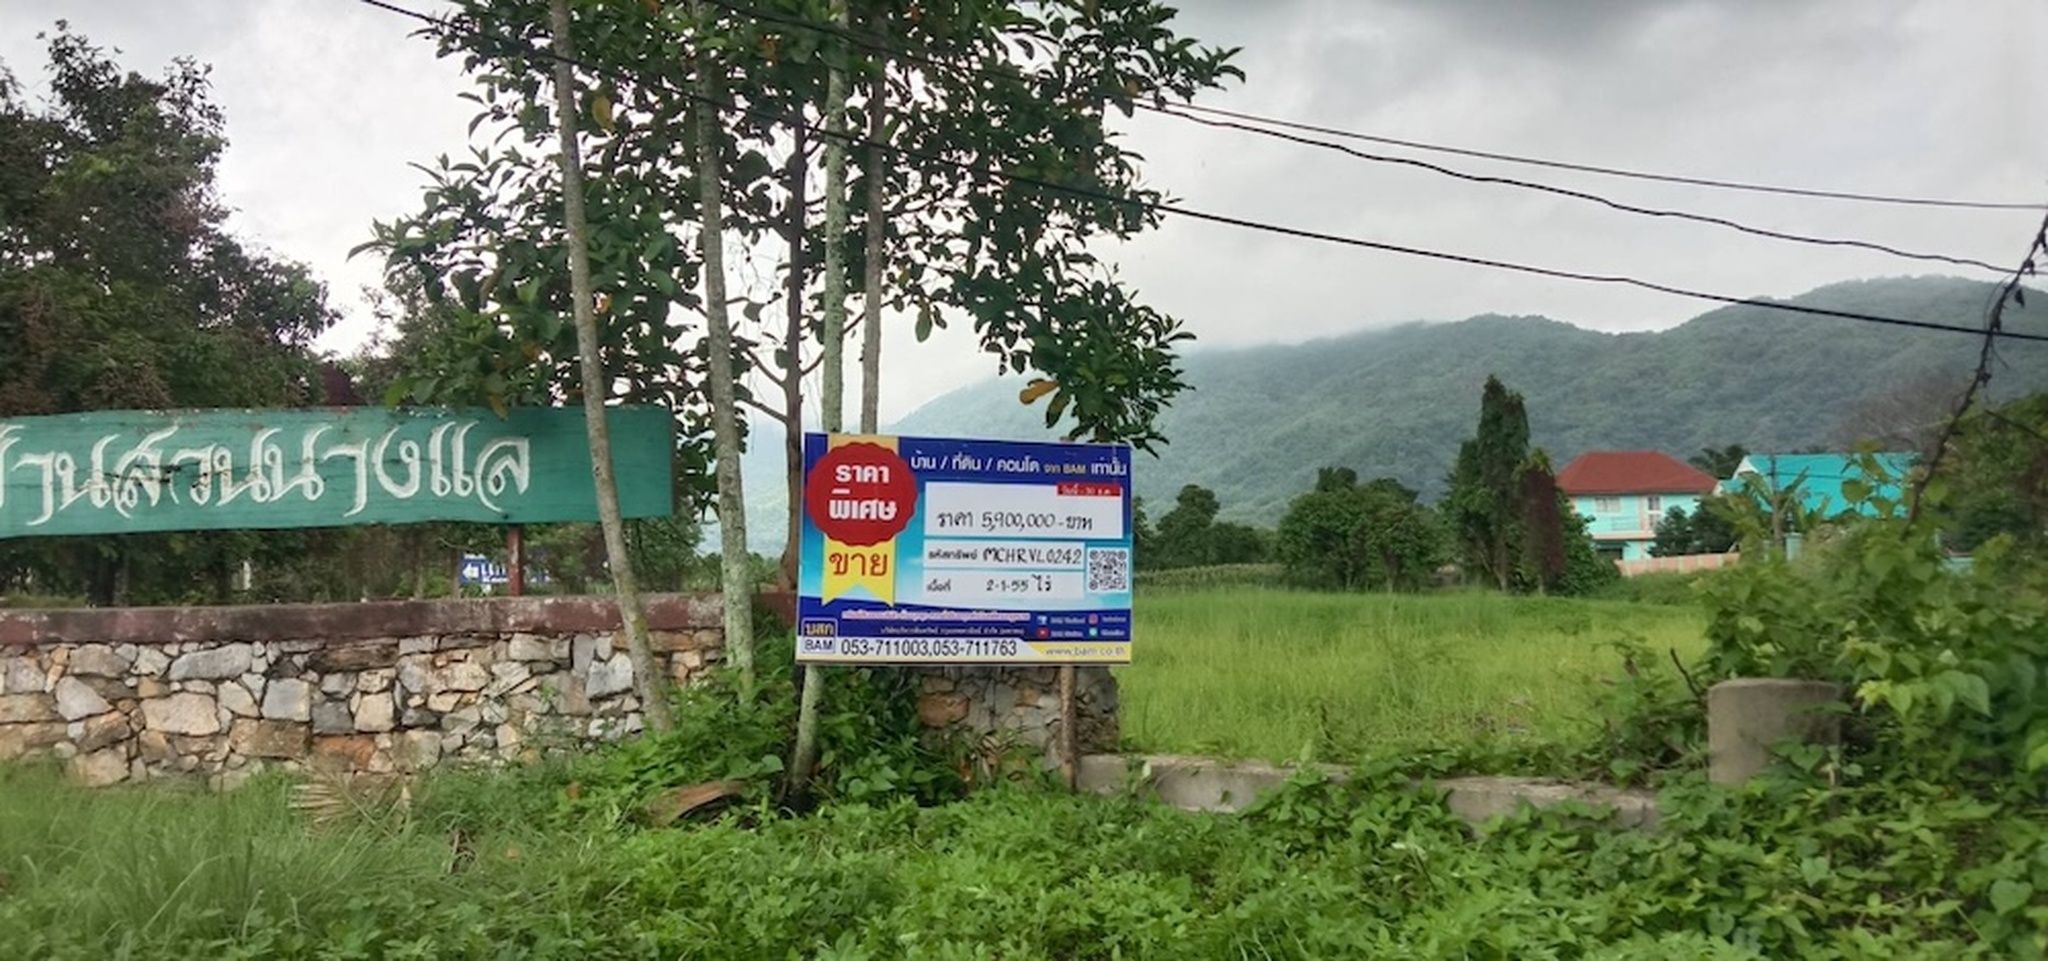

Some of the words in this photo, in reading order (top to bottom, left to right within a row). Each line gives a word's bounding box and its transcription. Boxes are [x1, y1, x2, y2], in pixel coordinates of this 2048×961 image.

[911, 450, 936, 470] บ้าน
[952, 453, 982, 472] ที่ดิน
[996, 454, 1040, 474] คอนโด
[1063, 464, 1087, 475] BAM
[1090, 456, 1128, 476] เท่านั้น
[835, 464, 890, 484] ราคา
[828, 487, 898, 520] พิเศษ
[937, 511, 974, 528] ราคา
[828, 552, 888, 577] ขาย
[1031, 574, 1052, 592] ไร่
[805, 621, 834, 636] บสก
[804, 638, 833, 651] BAM
